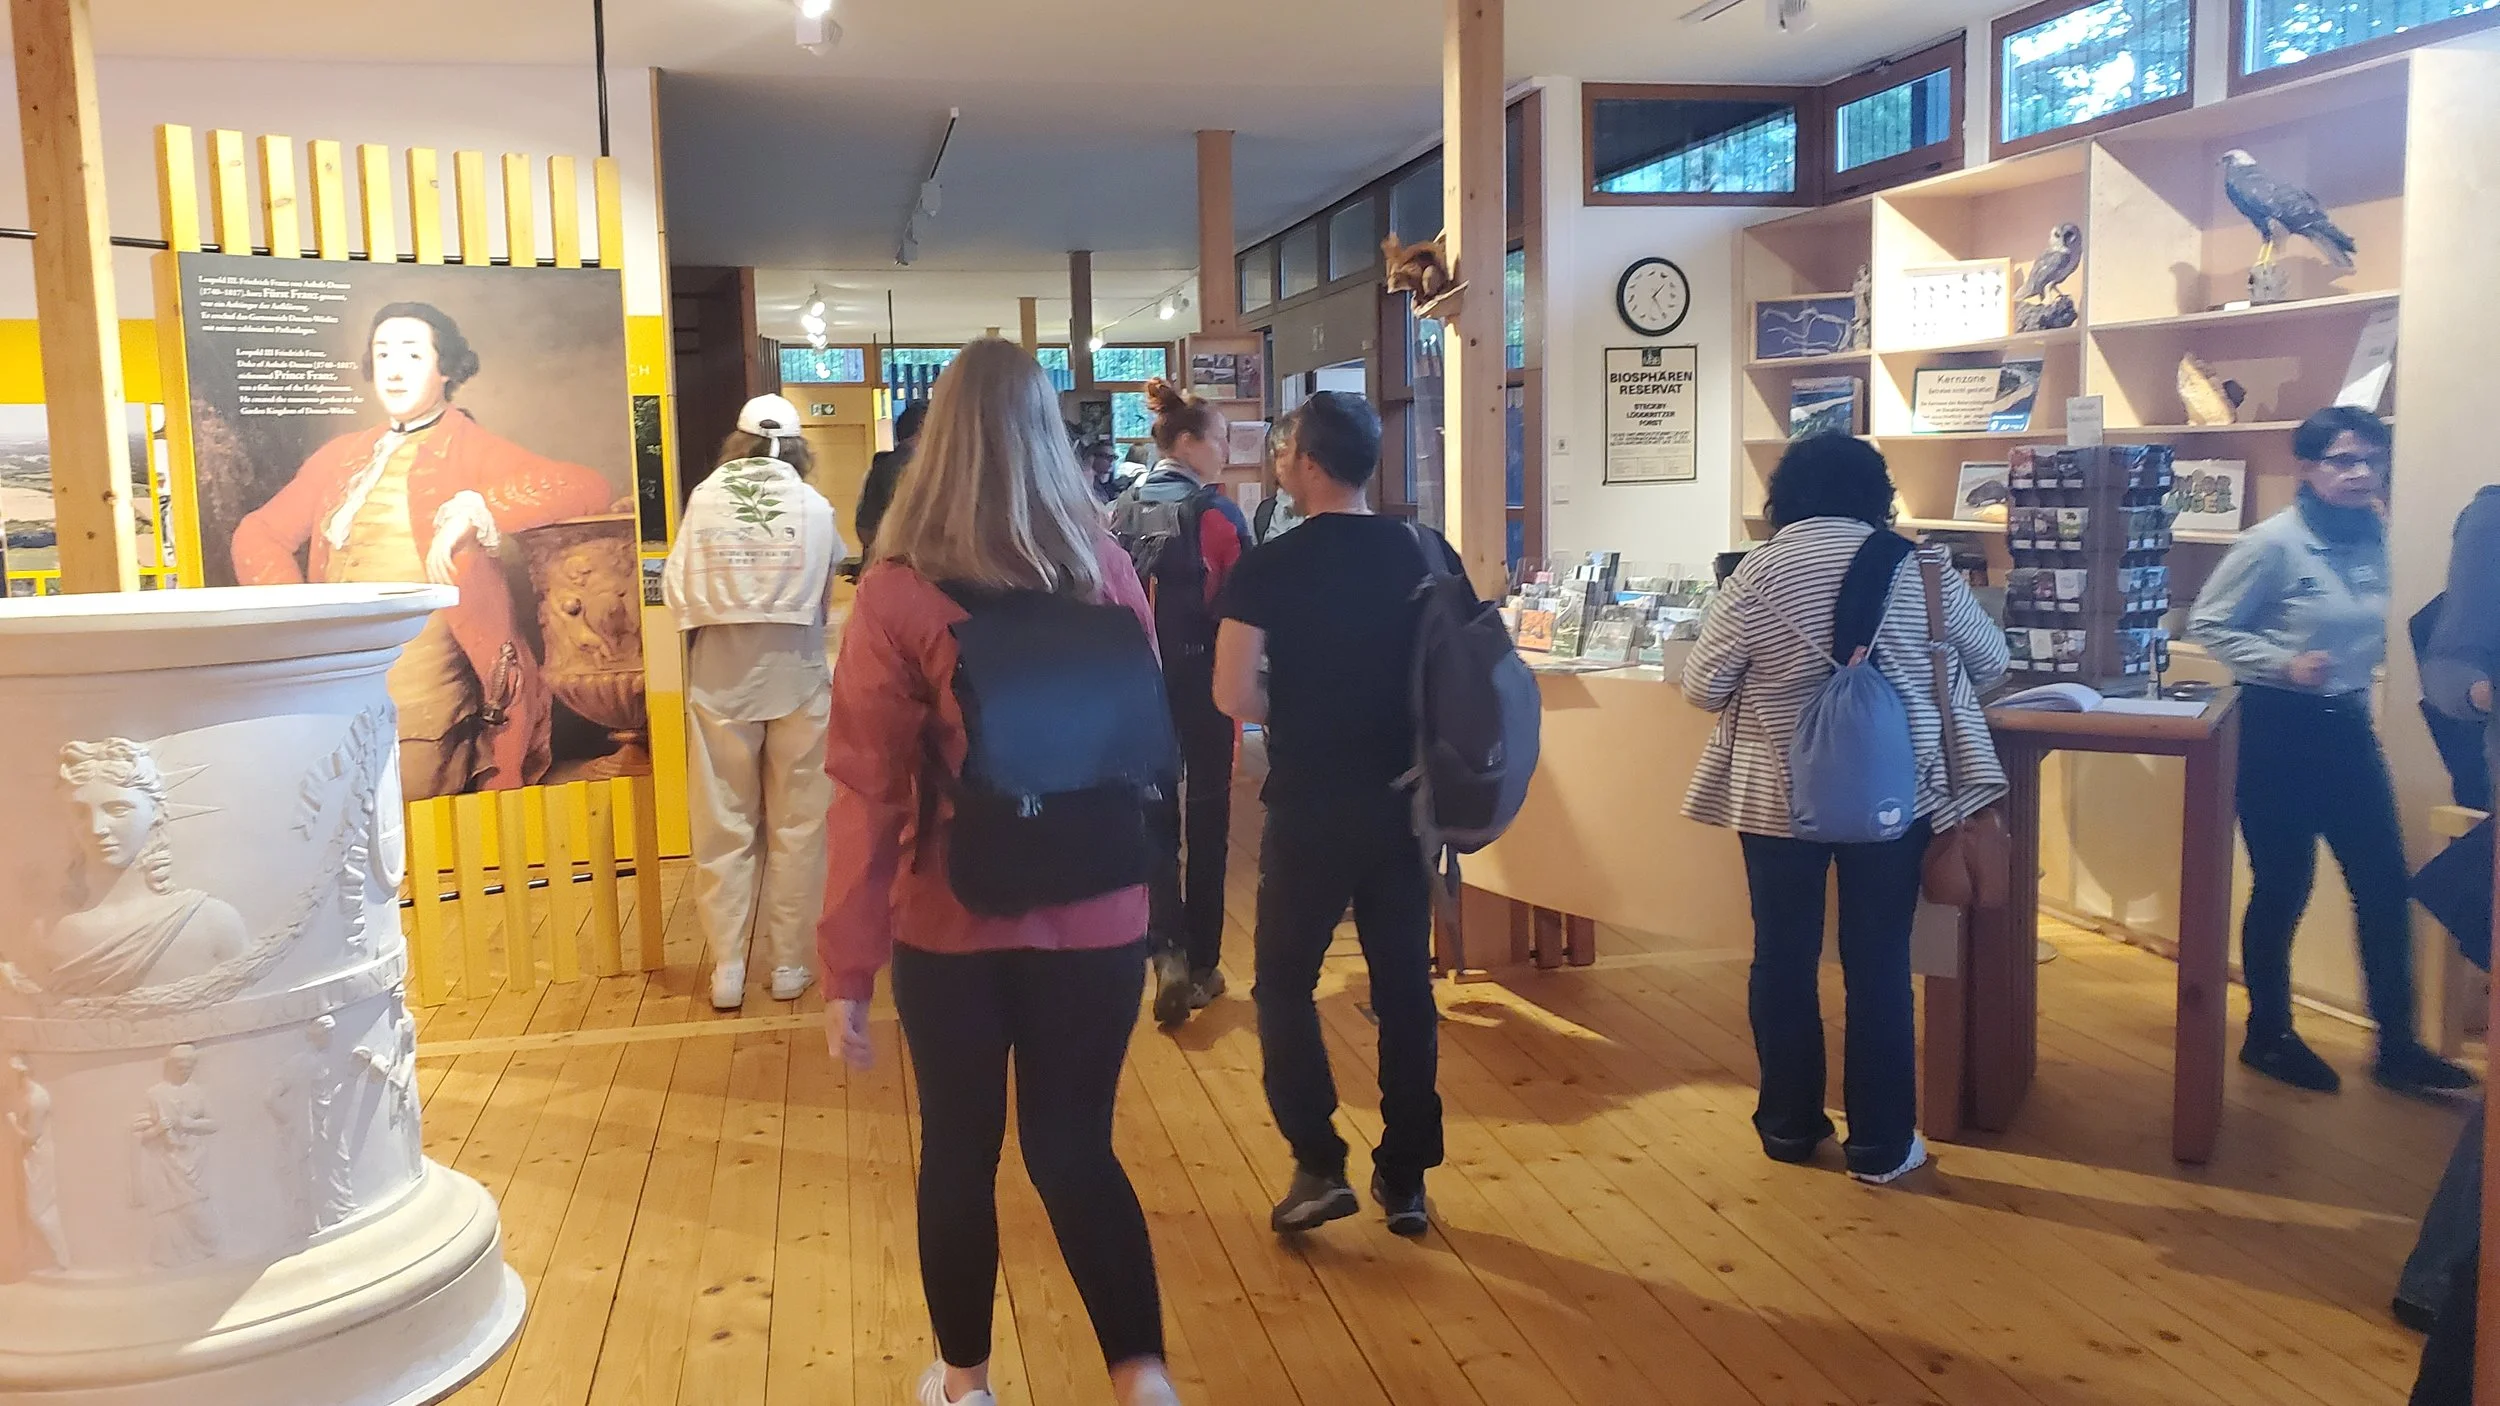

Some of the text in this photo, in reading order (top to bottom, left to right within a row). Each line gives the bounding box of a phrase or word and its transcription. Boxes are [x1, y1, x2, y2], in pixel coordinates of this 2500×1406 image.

[263, 287, 290, 298] Fürst
[290, 288, 320, 300] Franz
[274, 369, 306, 380] Prince
[1610, 370, 1693, 383] BIOSPHÄREN
[1937, 375, 1987, 384] Kernzone
[1619, 383, 1684, 395] RESERVAT
[1638, 419, 1664, 427] FORST
[2171, 469, 2232, 496] NIOR
[2164, 491, 2237, 514] ANGER
